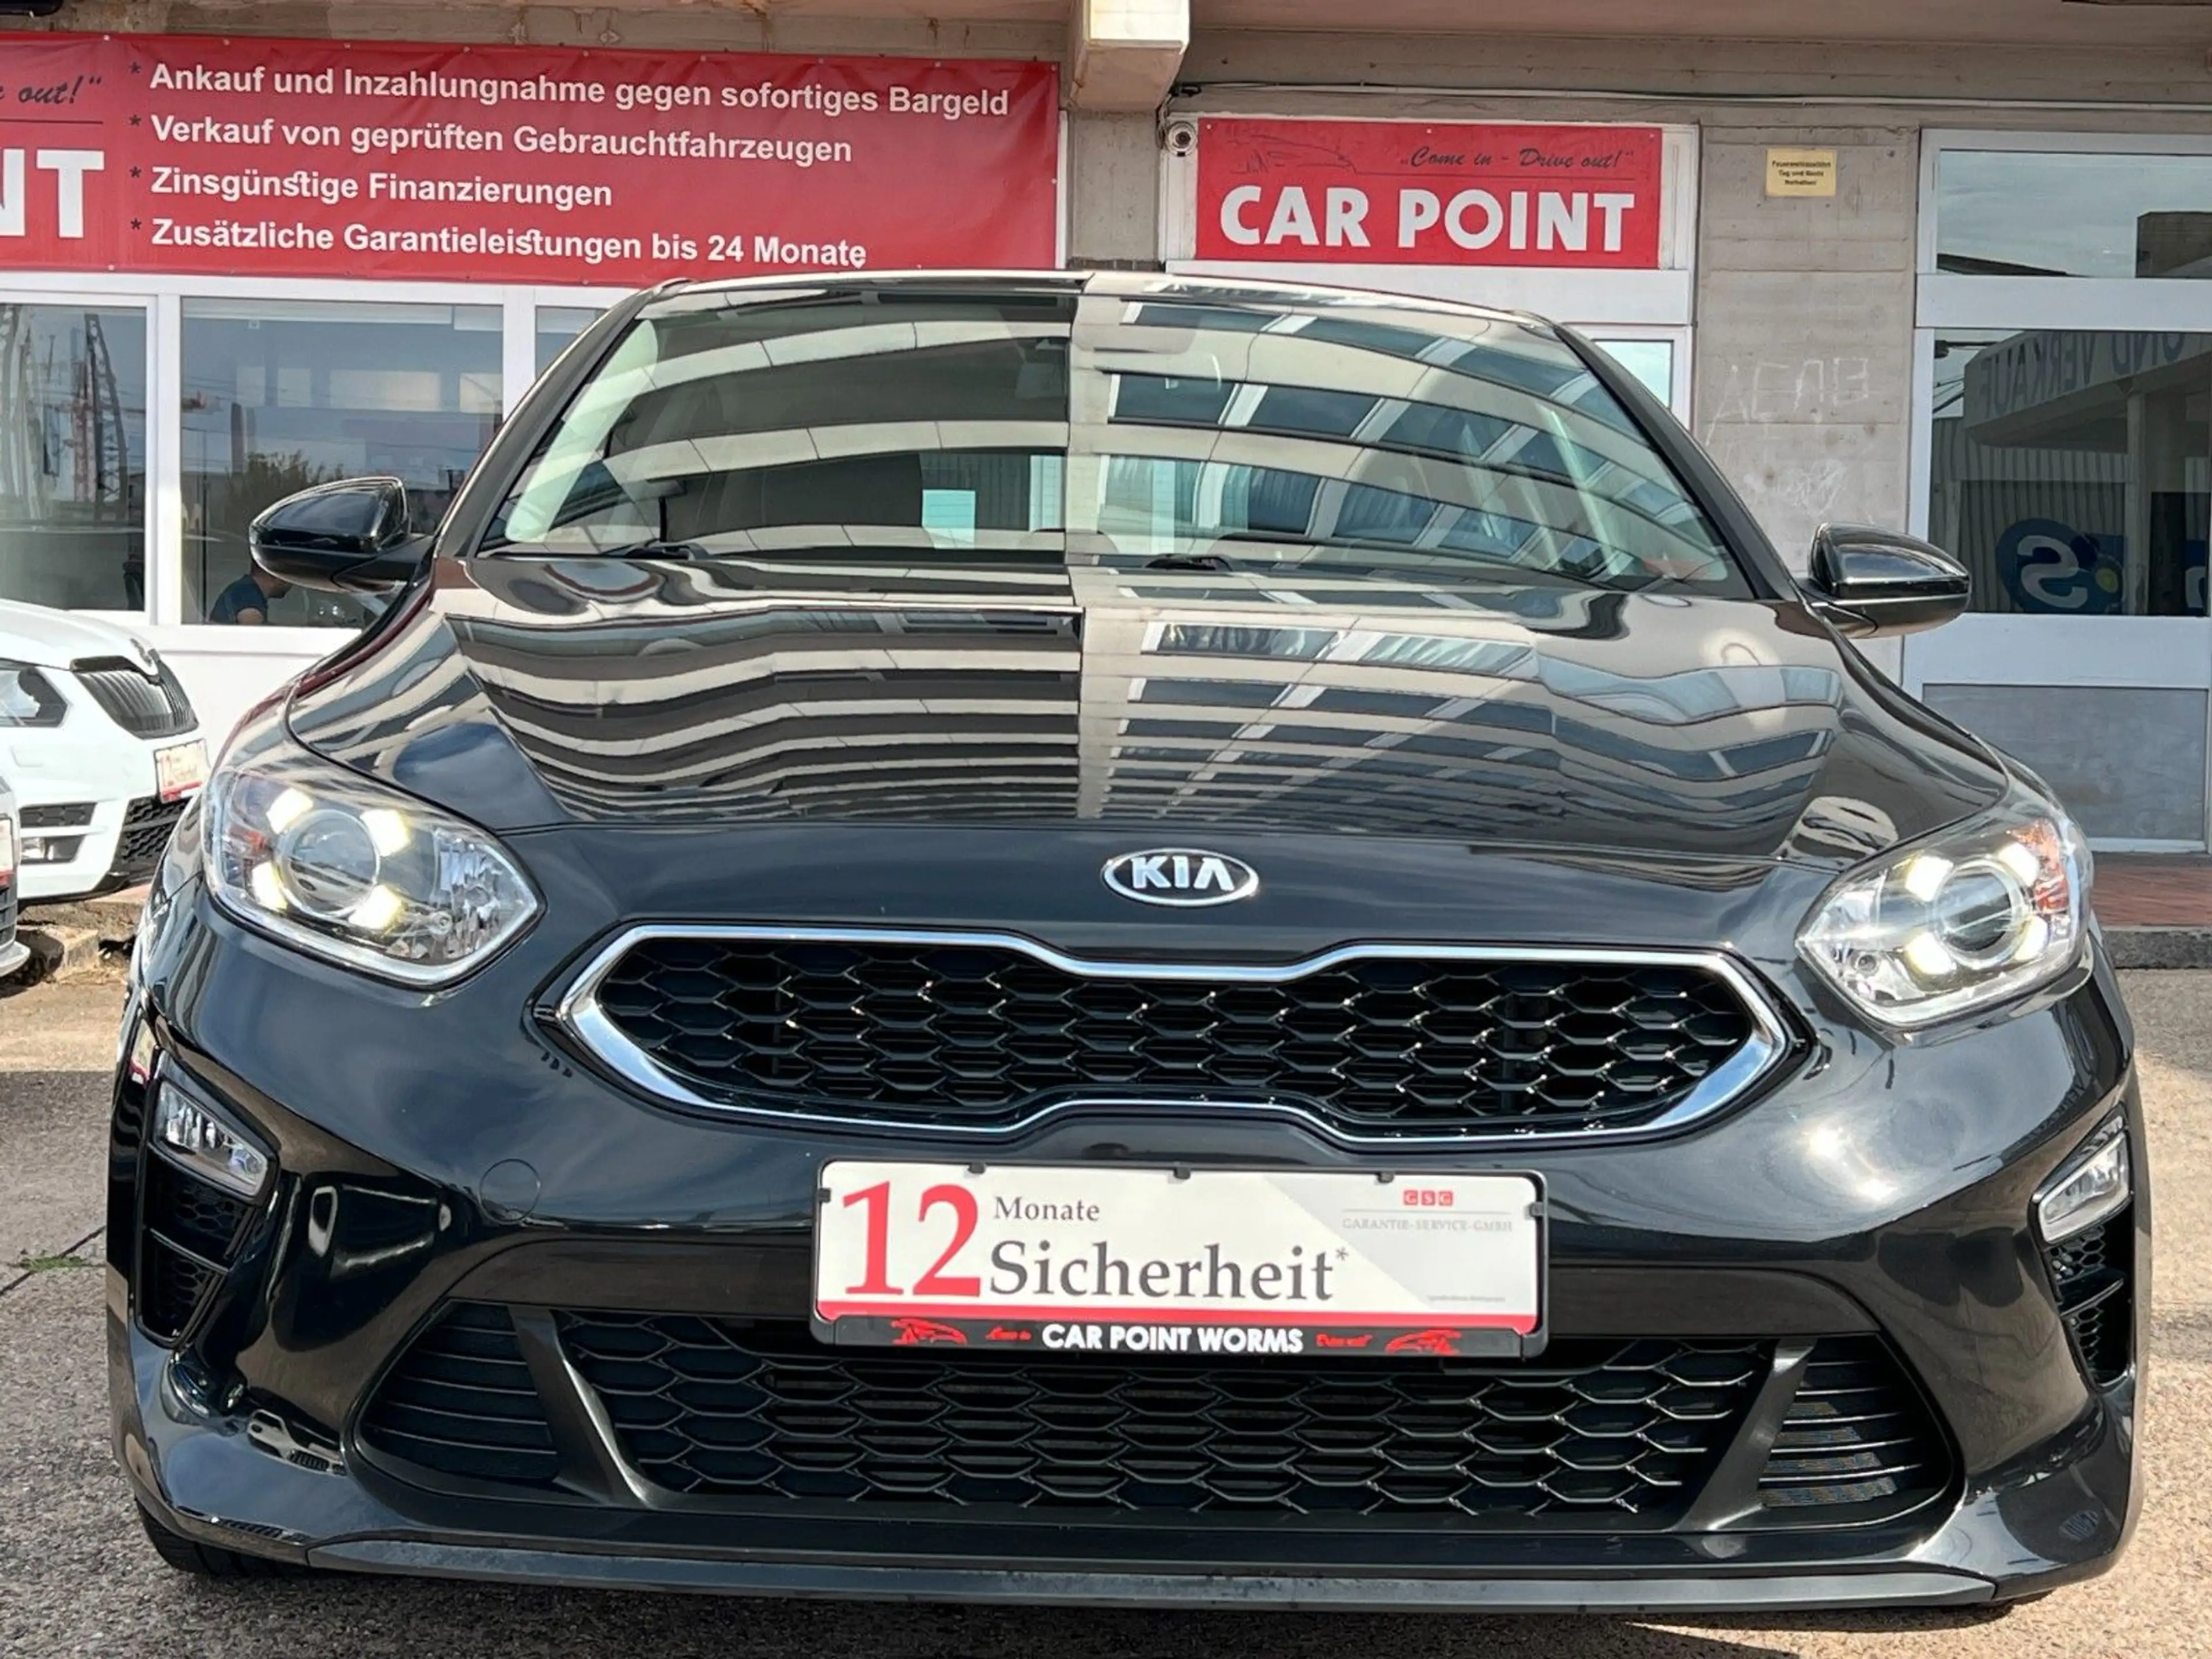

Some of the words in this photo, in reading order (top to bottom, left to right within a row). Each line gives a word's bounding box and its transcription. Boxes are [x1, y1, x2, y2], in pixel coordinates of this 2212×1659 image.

[150, 63, 265, 92] Ankauf
[274, 68, 334, 94] und
[345, 69, 605, 105] Inzahlungnahme
[615, 84, 710, 111] gegen
[721, 82, 878, 117] sofortiges
[889, 87, 1008, 120] Bargeld
[150, 114, 275, 145] Verkauf
[281, 125, 340, 146] von
[351, 122, 503, 154] geprüften
[513, 125, 852, 165] Gebrauchtfahrzeugen
[150, 166, 359, 204] Zinsgünstige
[369, 172, 612, 211] Finanzierungen
[151, 218, 335, 250] Zusätzliche
[343, 223, 642, 264] Garantieleistungen
[652, 233, 698, 260] bis
[707, 234, 745, 262] 24
[754, 236, 867, 268] Monate
[1220, 185, 1371, 247] CAR
[1397, 189, 1635, 252] POINT
[1130, 855, 1235, 891] KIA
[993, 1196, 1100, 1221] Monate
[842, 1180, 982, 1297] 12
[1041, 1324, 1103, 1349] CAR
[1109, 1325, 1192, 1351] POINT
[1196, 1327, 1304, 1354] WORMS
